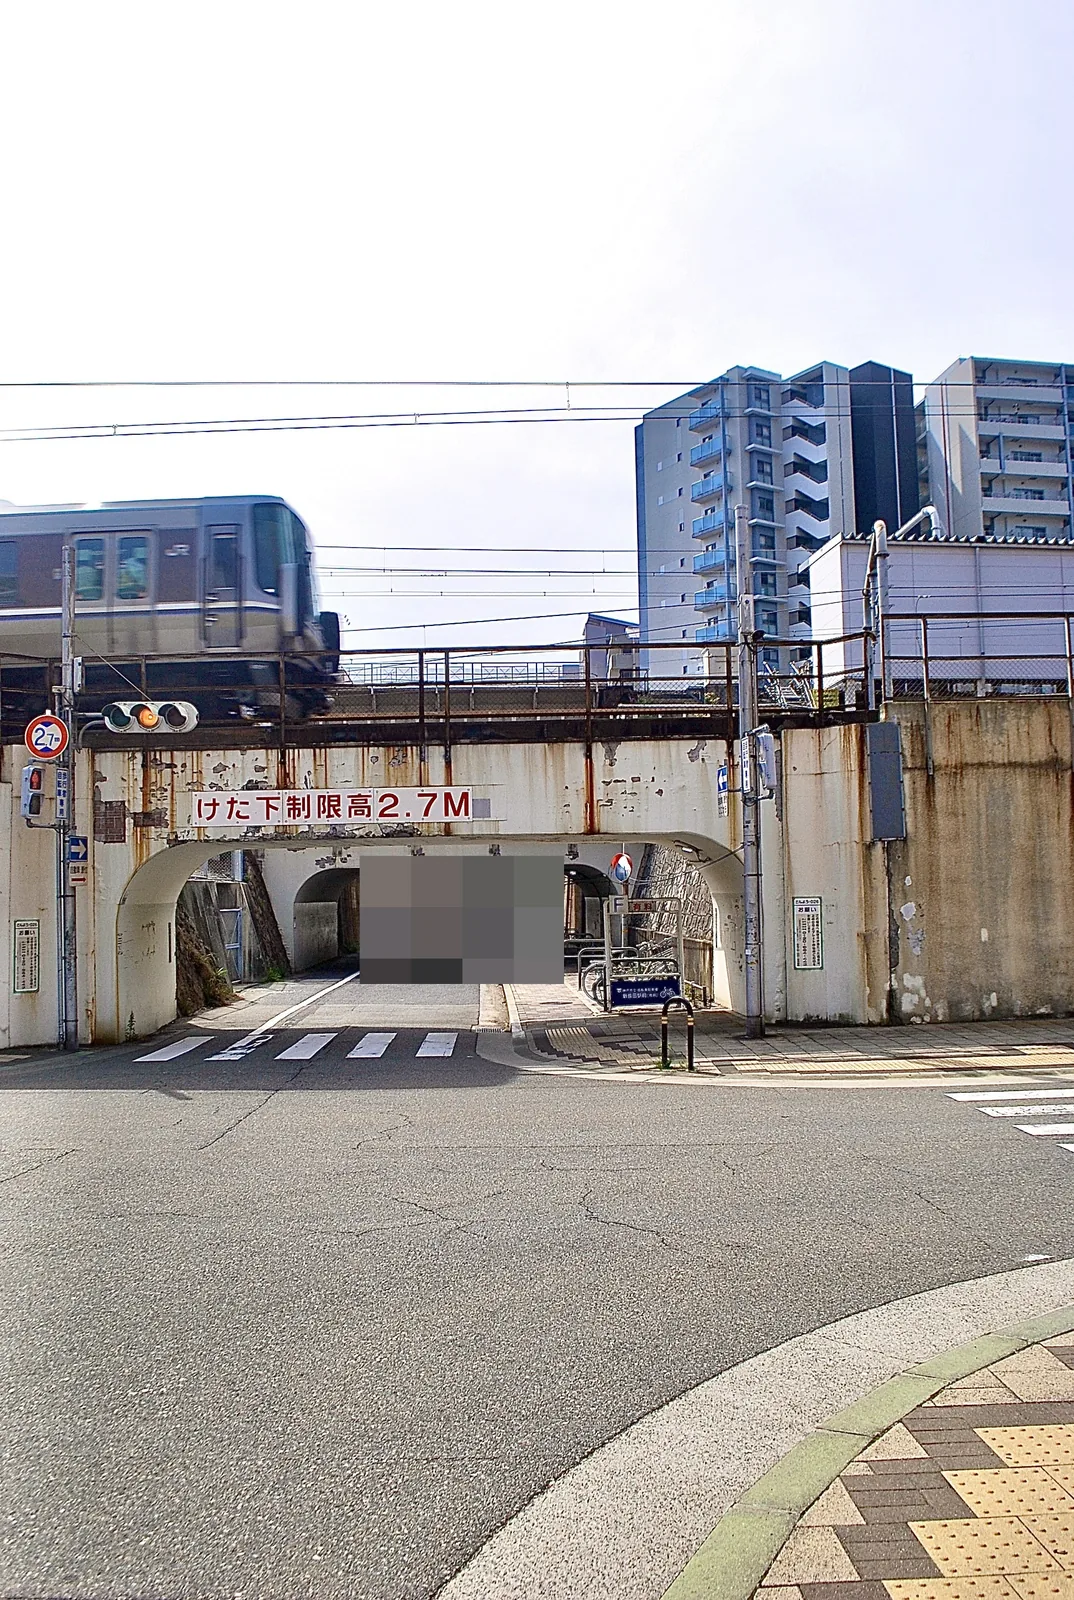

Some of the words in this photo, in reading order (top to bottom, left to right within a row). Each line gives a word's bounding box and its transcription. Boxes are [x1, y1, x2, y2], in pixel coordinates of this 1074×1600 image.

[164, 544, 190, 557] JR
[197, 791, 470, 821] けた下制限高2.7M
